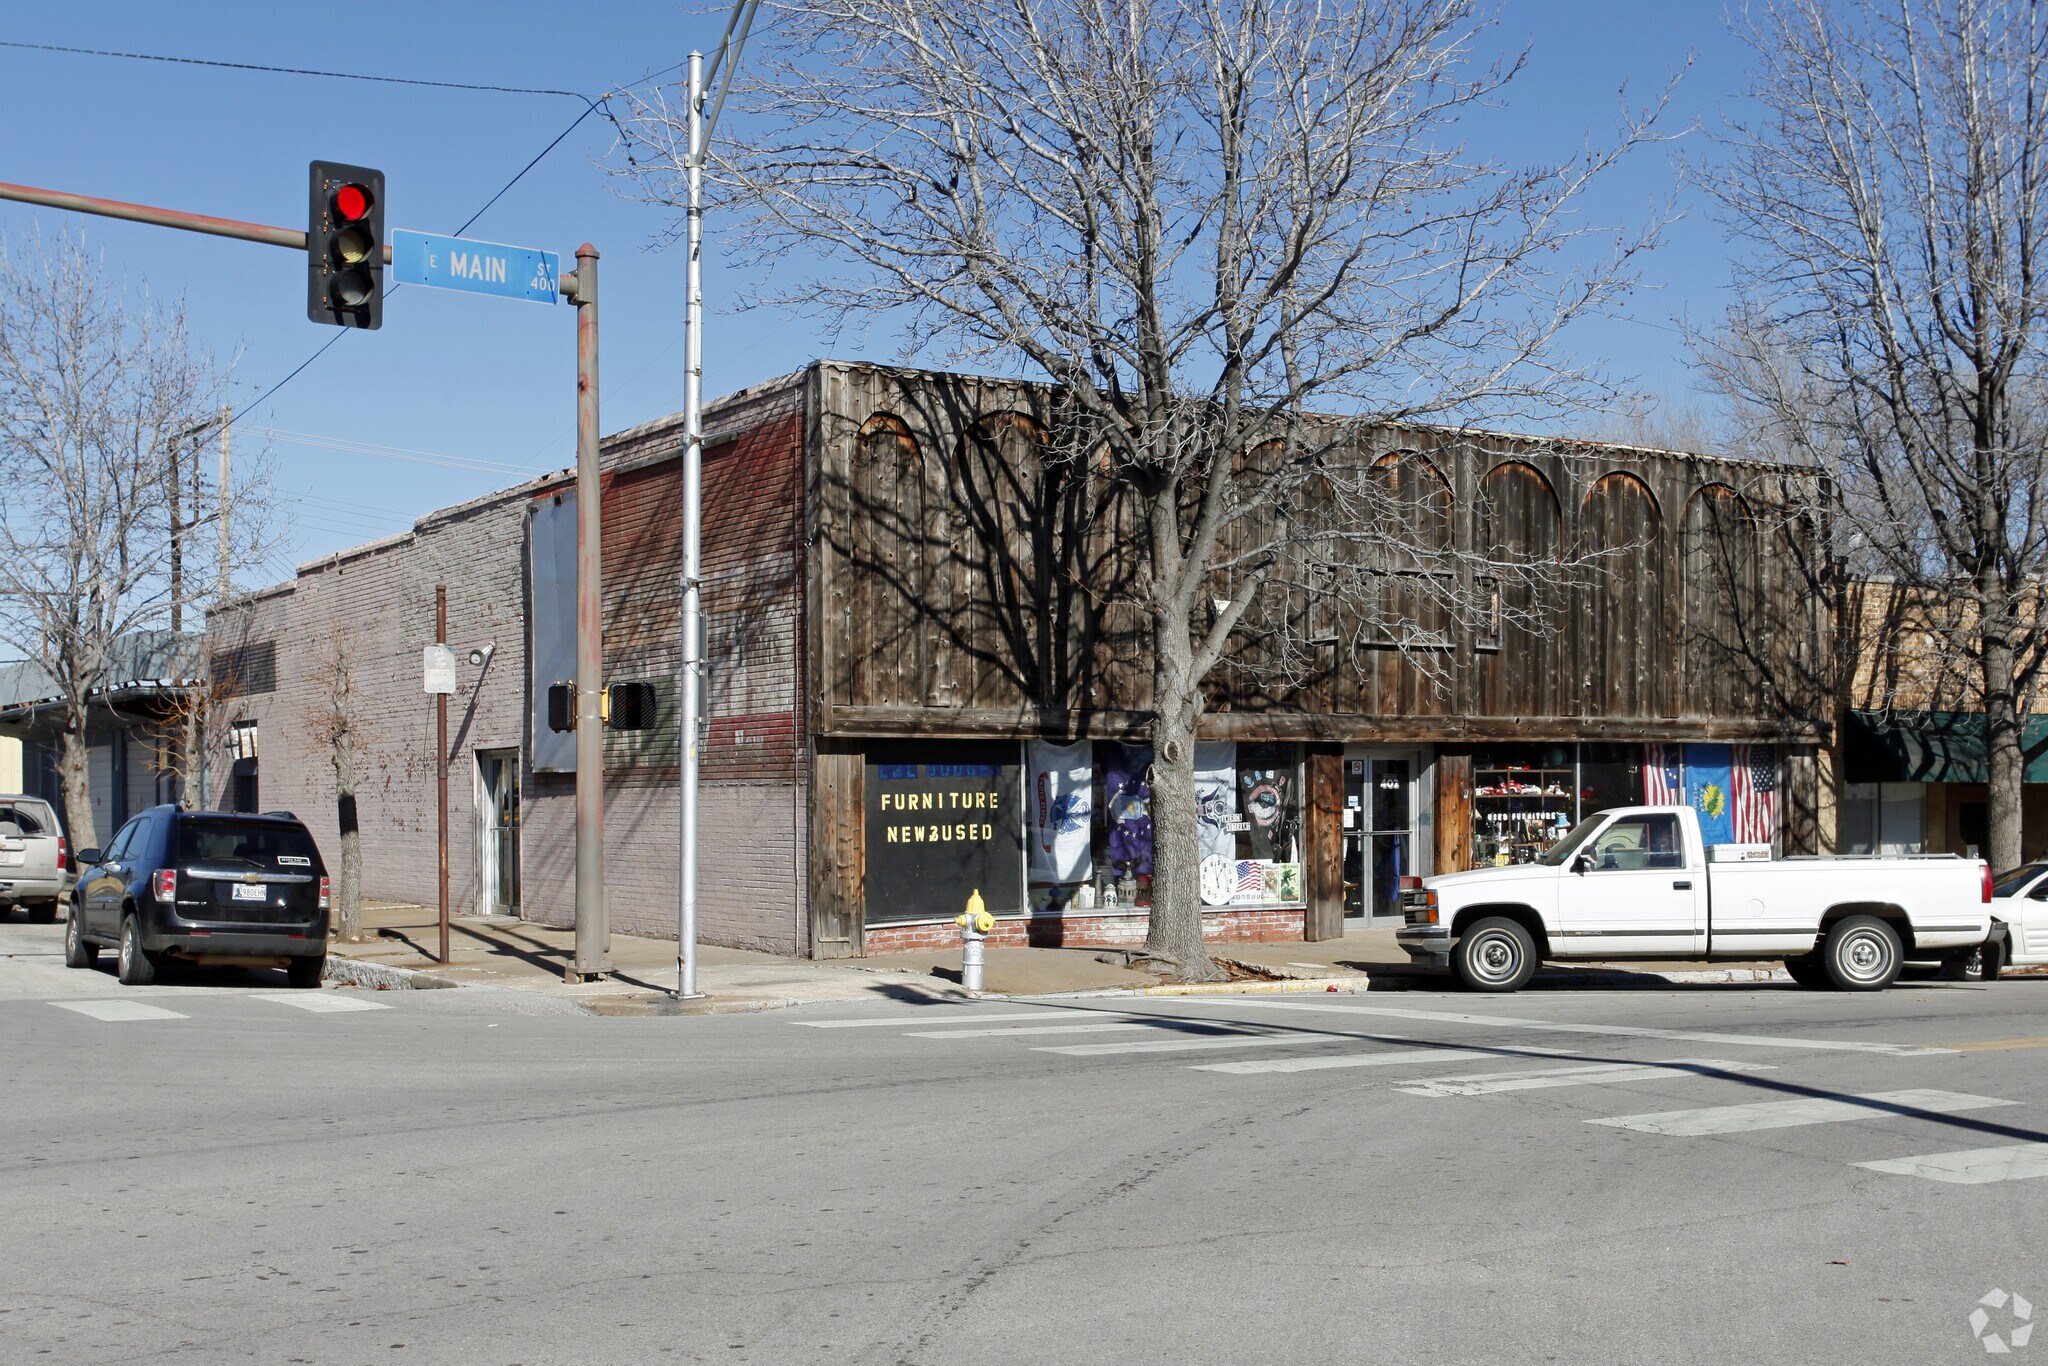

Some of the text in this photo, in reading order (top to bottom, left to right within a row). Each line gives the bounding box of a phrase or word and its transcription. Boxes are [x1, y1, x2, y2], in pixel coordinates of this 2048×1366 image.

[430, 251, 551, 283] E MAIN ST
[530, 277, 556, 292] 400
[1380, 779, 1400, 789] 402
[881, 792, 999, 811] FURNITURE
[1487, 811, 1556, 821] USED FURNITURE
